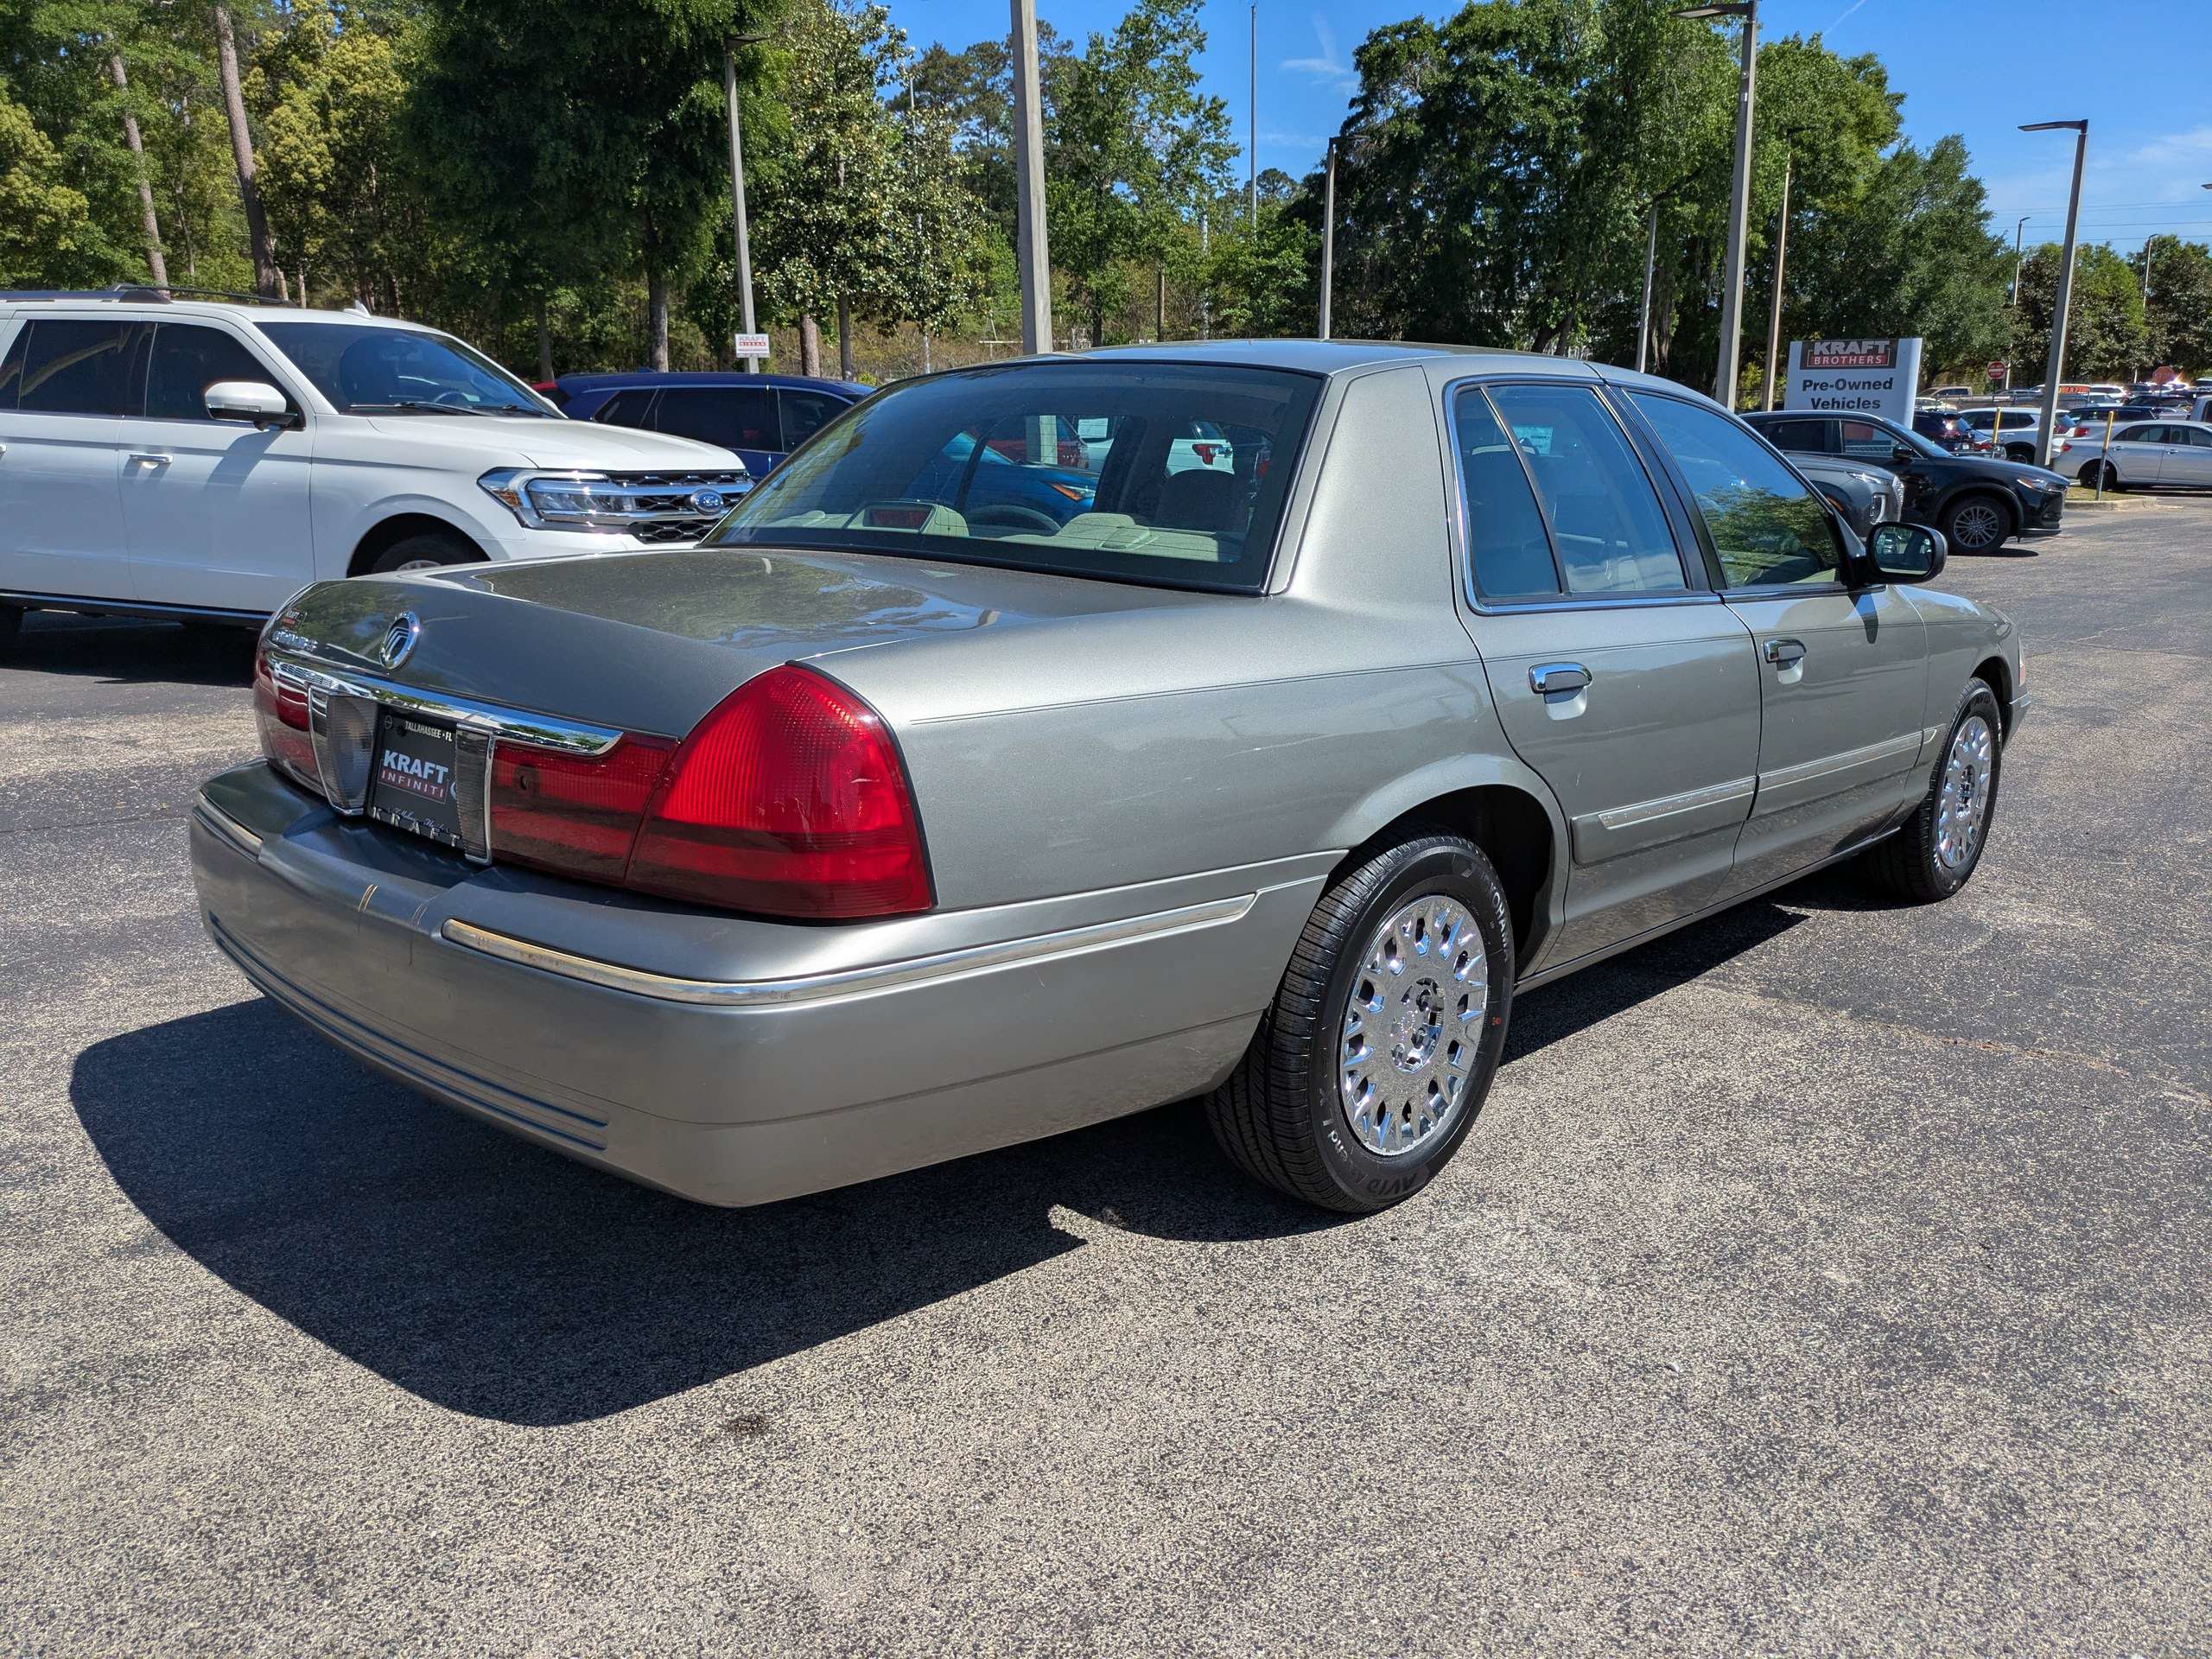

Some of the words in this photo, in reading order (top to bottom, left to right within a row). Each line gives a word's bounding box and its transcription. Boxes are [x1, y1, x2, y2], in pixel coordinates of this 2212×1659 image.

[1814, 340, 1891, 355] KRAFT
[1814, 355, 1882, 365] BROTHERS
[1802, 377, 1894, 391] Pre-Owned
[1810, 397, 1881, 410] Vehicles
[404, 720, 442, 739] TALLAHASSEE
[445, 731, 453, 741] FL
[383, 749, 448, 784] KRAFT
[381, 770, 443, 798] INFINITI
[372, 806, 461, 847] KRAFT
